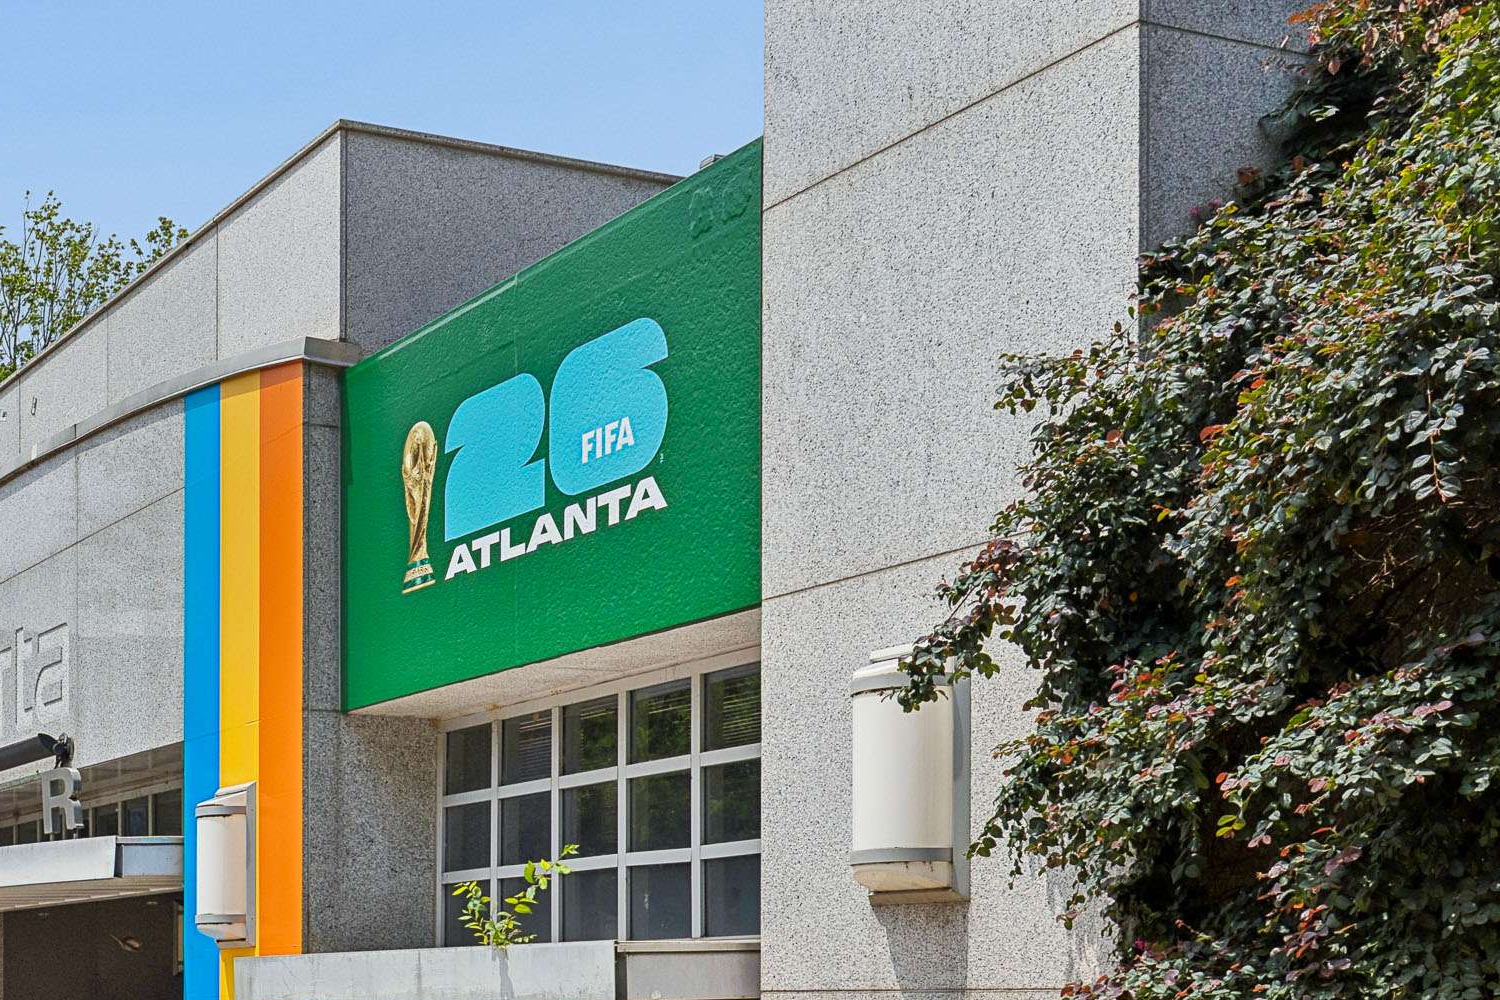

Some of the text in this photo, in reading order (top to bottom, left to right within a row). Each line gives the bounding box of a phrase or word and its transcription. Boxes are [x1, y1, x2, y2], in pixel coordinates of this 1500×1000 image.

[445, 317, 669, 542] 26
[581, 416, 635, 464] FIFA
[445, 476, 669, 580] ATLANTA
